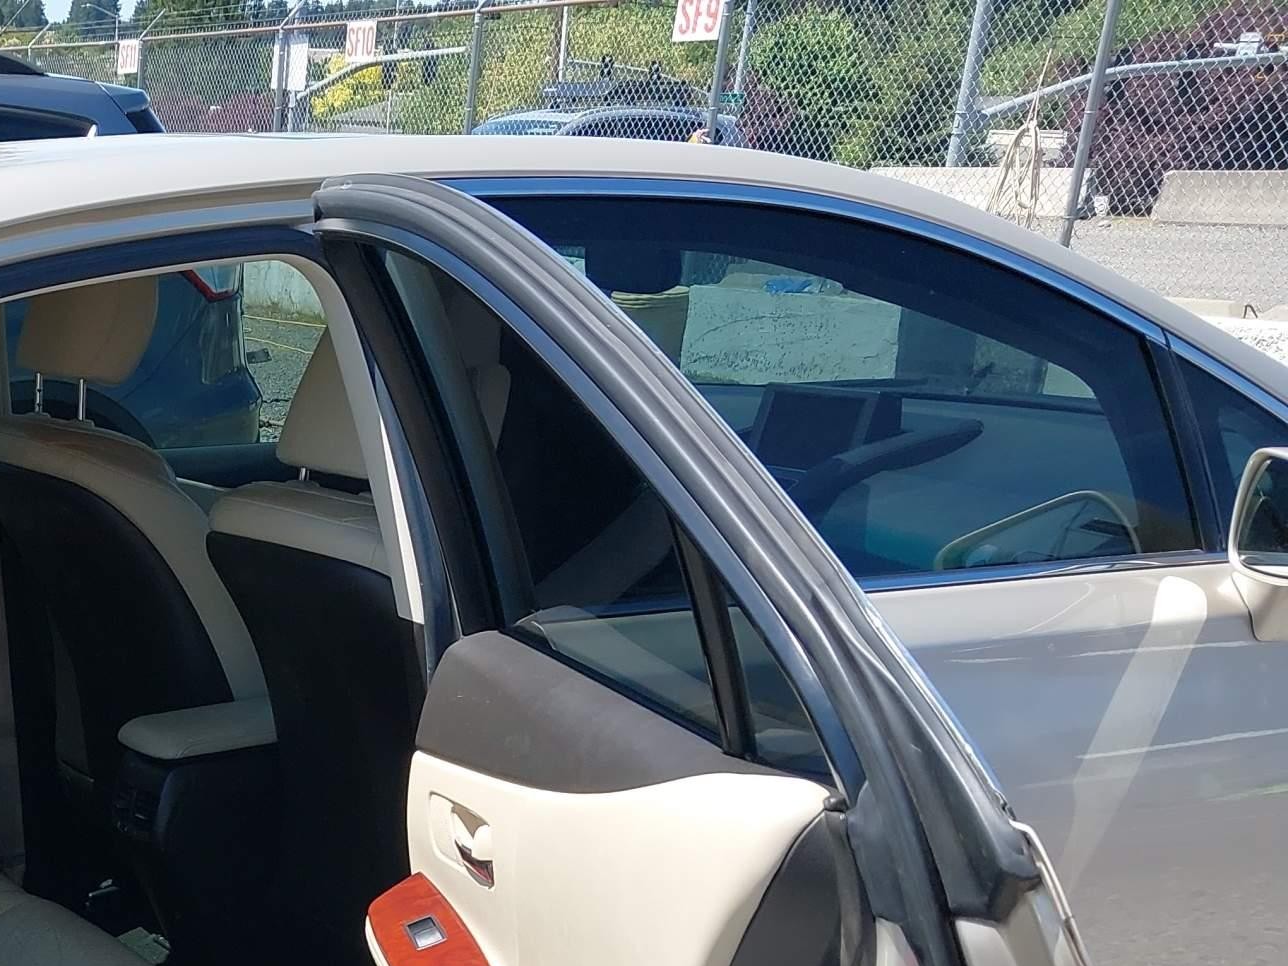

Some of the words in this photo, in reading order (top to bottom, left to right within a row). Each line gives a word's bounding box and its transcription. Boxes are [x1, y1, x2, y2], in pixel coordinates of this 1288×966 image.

[679, 0, 720, 34] SF9
[120, 43, 137, 69] SF11
[347, 26, 375, 57] SF10
